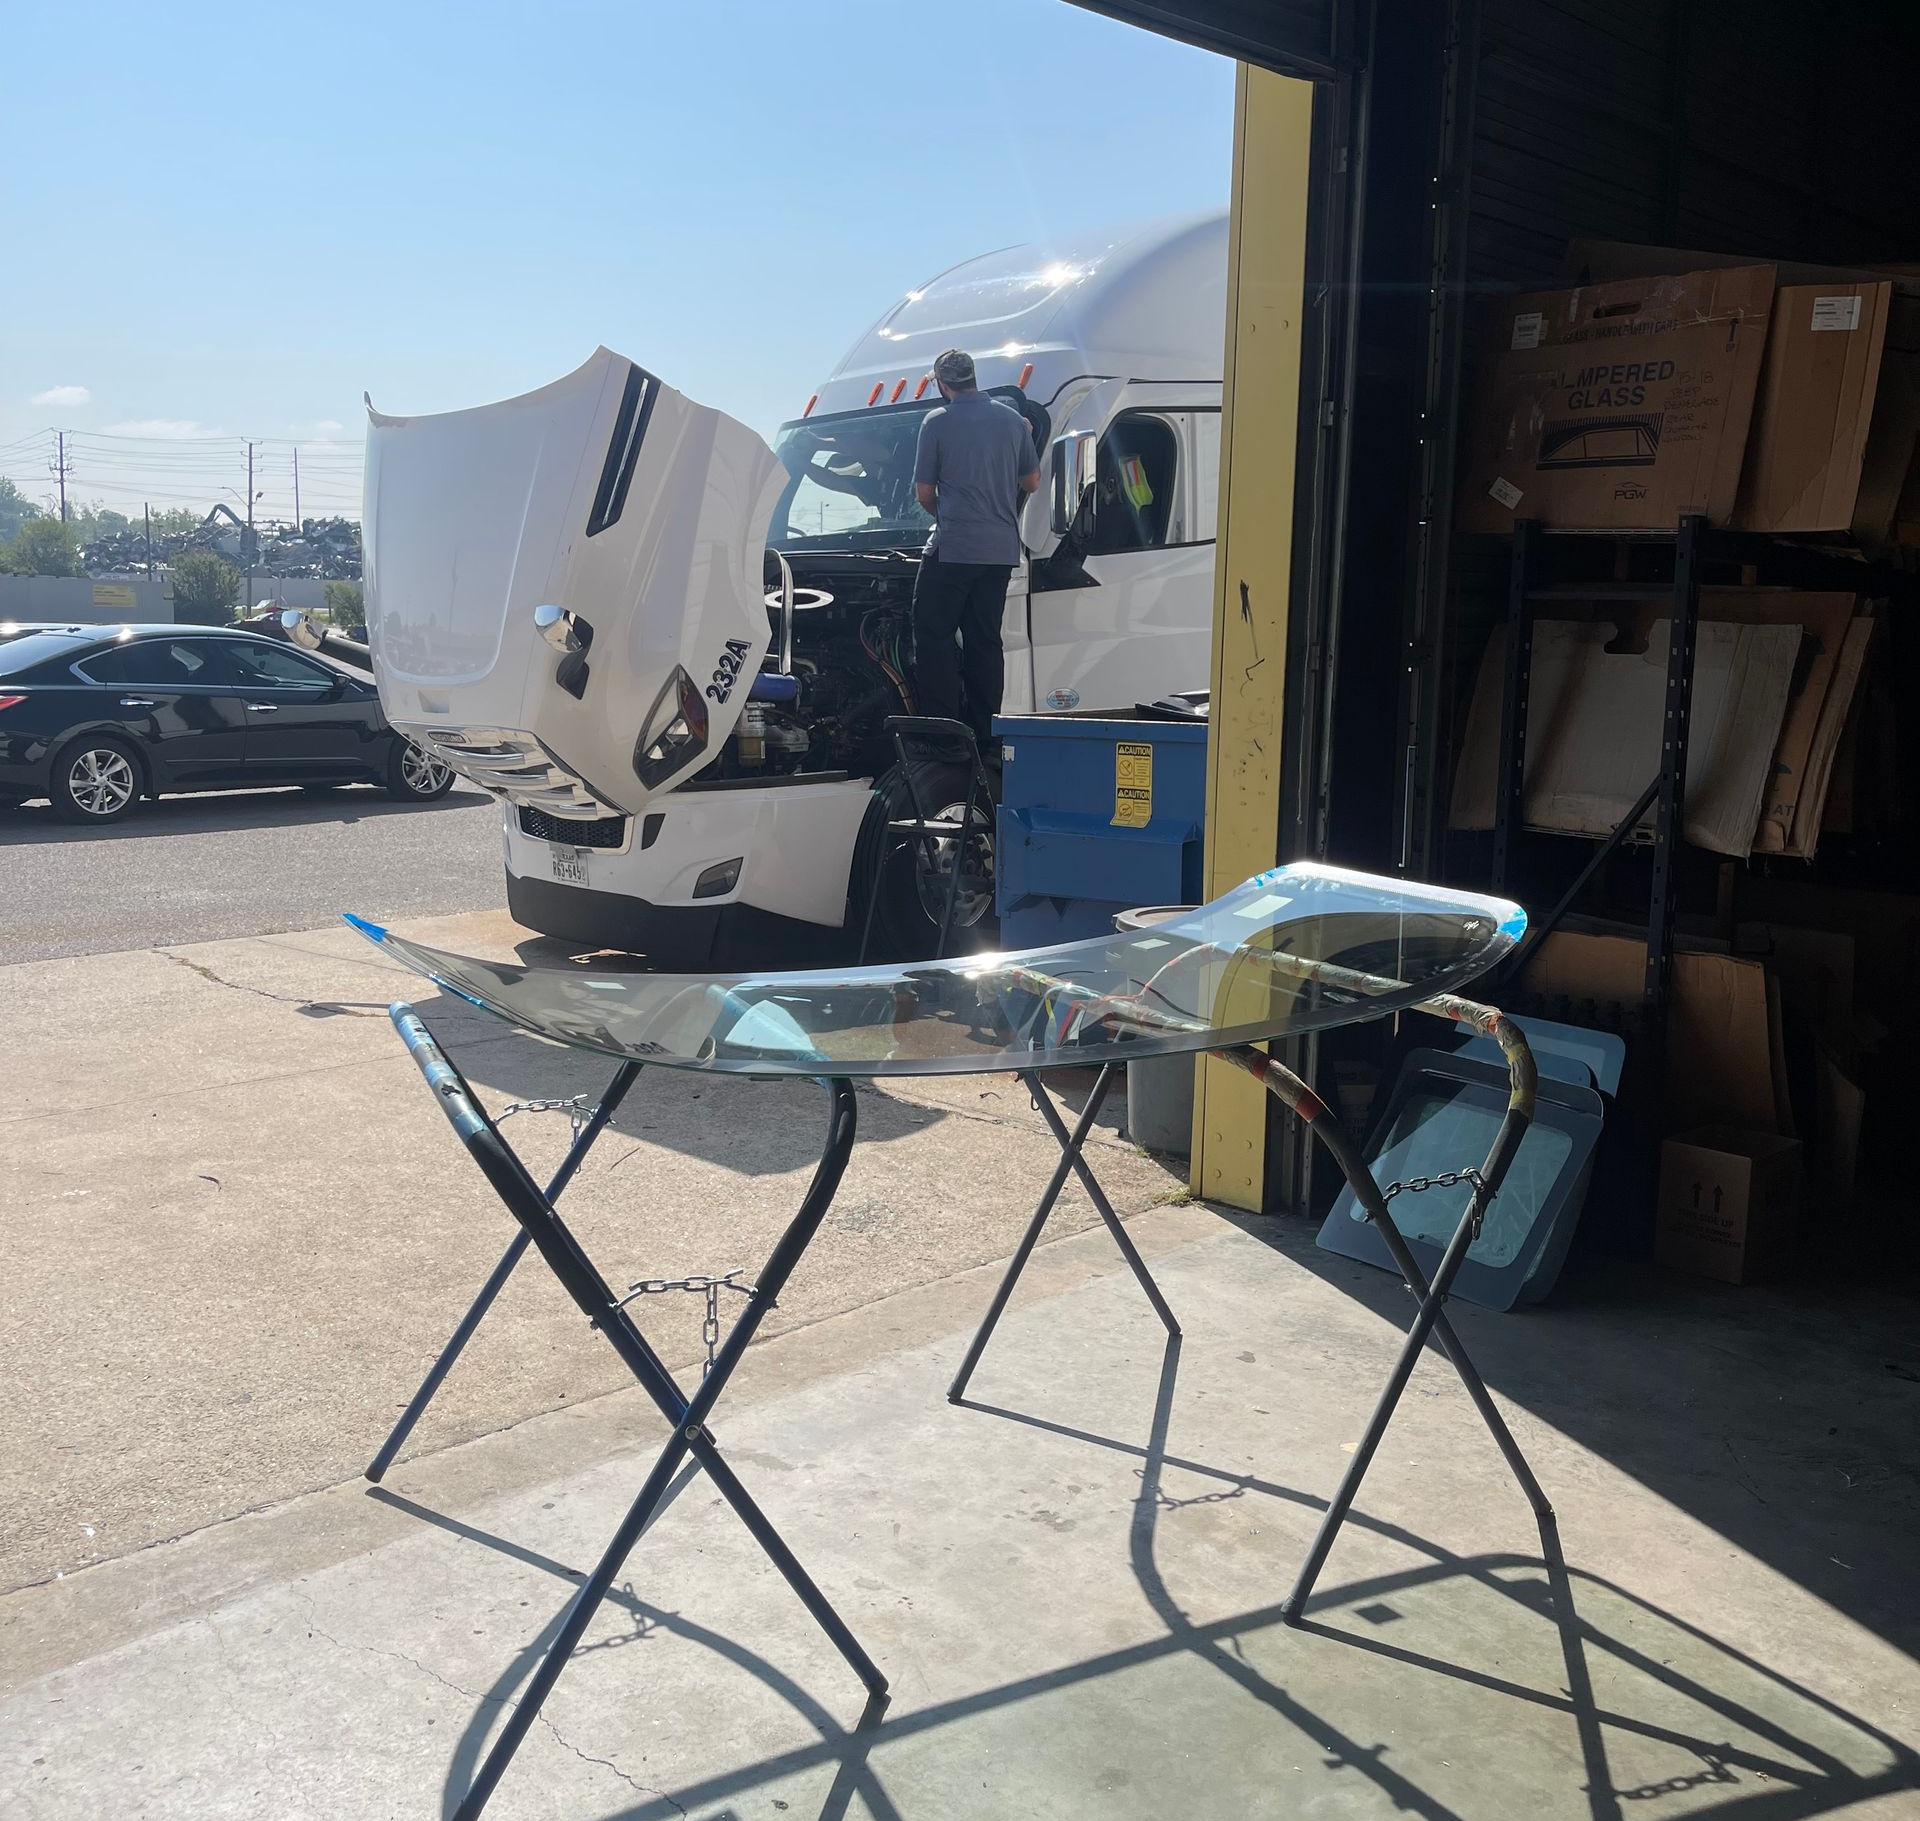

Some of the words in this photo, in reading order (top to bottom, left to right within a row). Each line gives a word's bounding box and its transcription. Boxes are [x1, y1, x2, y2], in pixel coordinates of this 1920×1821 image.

[1568, 385, 1645, 410] GLASS
[1614, 488, 1648, 500] PGW
[706, 638, 752, 704] 232A
[1124, 745, 1151, 756] CAUTION
[1123, 789, 1150, 800] CAUTION
